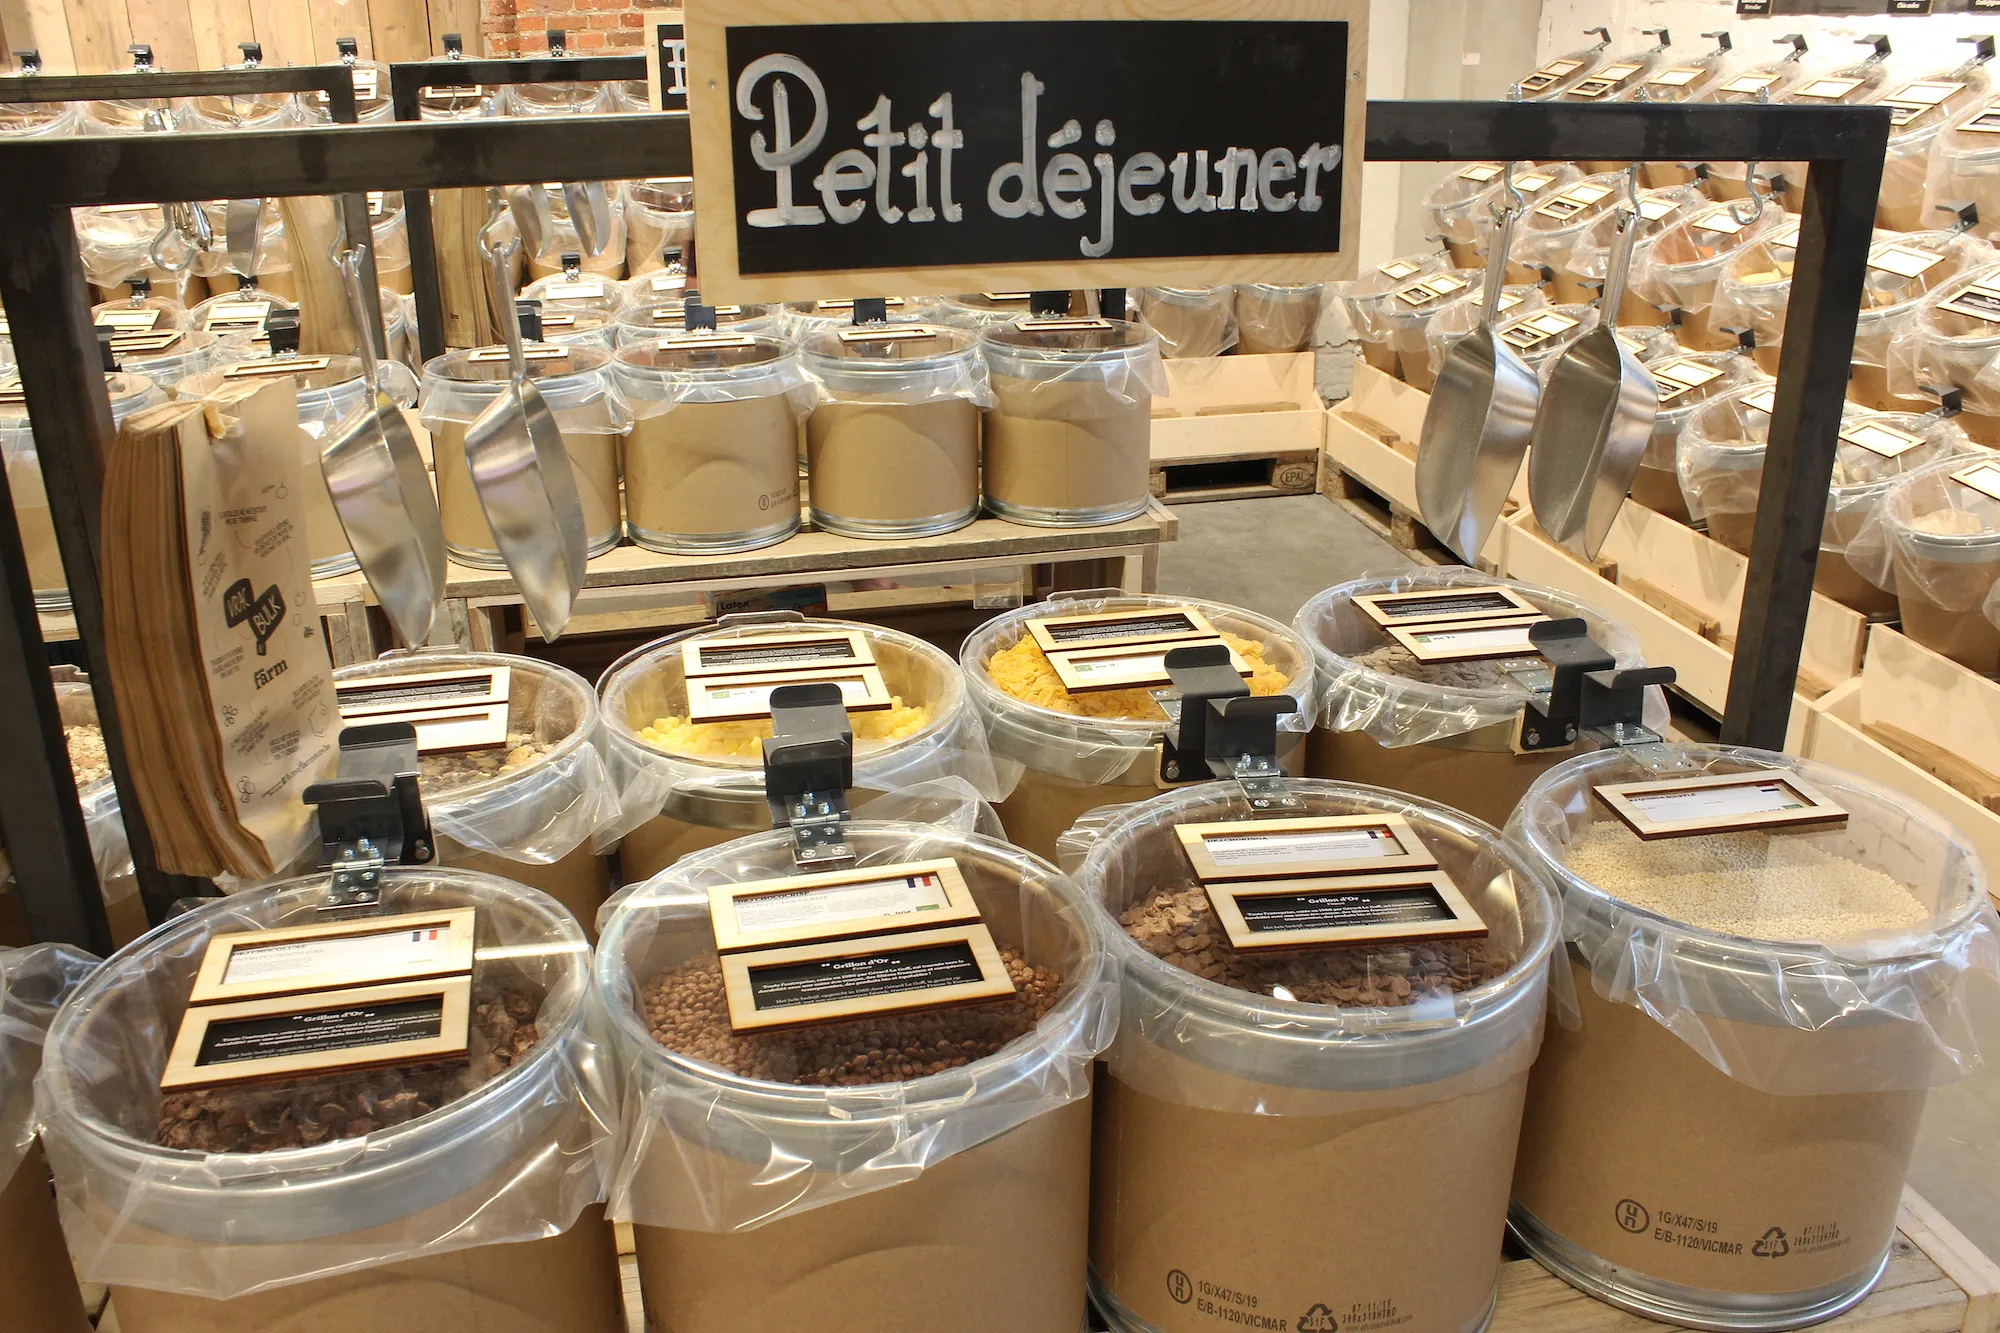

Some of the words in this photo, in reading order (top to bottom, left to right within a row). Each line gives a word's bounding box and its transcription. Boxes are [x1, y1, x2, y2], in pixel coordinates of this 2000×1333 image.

[736, 53, 964, 227] Petit
[988, 71, 1342, 257] déjeuner
[1285, 471, 1306, 483] EPAL
[227, 586, 250, 618] VRAC
[252, 595, 281, 635] BULK
[719, 600, 751, 611] Latex
[253, 659, 288, 690] färm
[833, 961, 867, 970] Grillon
[867, 958, 889, 966] d'Or
[304, 1014, 340, 1022] Grillon
[1656, 1209, 1718, 1234] 1G/X47/S/19
[1654, 1227, 1743, 1256] E/B-1120/VICMAR
[1197, 1280, 1258, 1309] 1G/X47/S/19
[1197, 1298, 1287, 1332] E/B-1120/VICMAR
